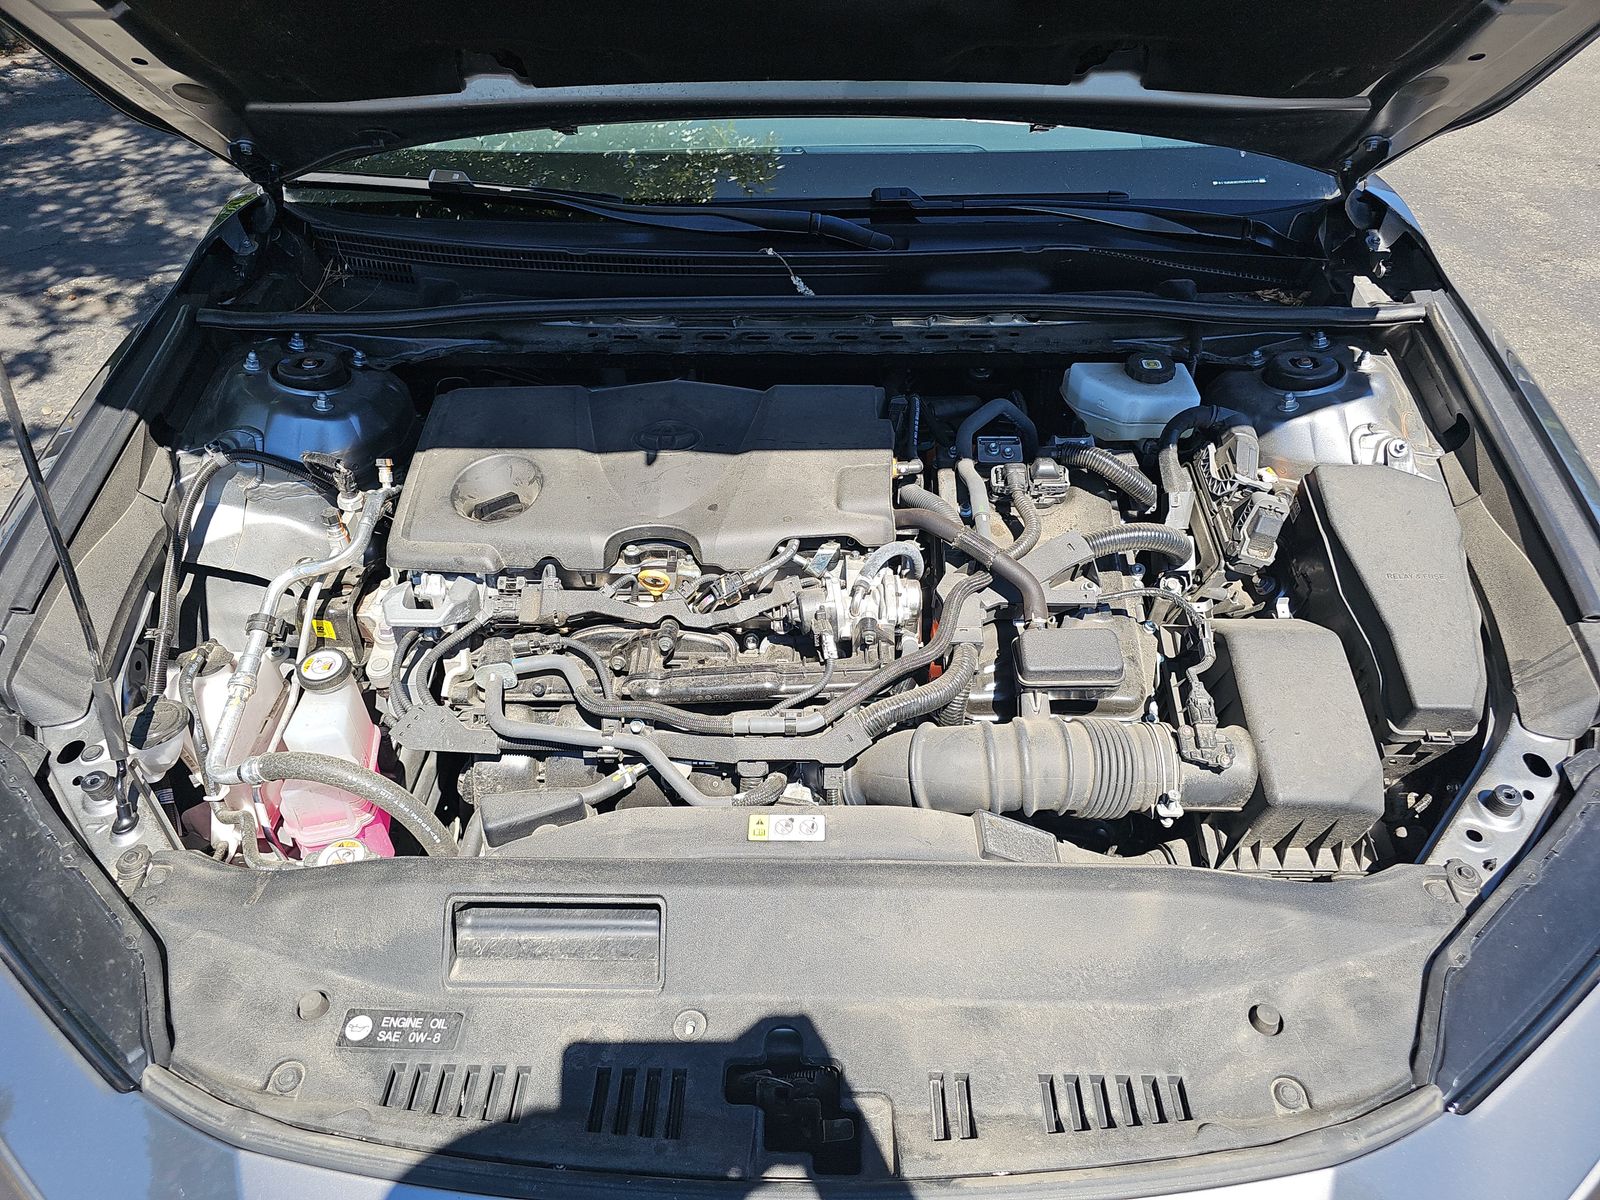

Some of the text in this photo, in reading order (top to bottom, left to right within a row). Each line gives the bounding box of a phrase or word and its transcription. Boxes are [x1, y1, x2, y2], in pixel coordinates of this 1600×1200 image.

[1386, 572, 1414, 581] RELAY
[380, 1016, 448, 1030] ENGINE OIL
[376, 1030, 441, 1043] SAE 0W-8
